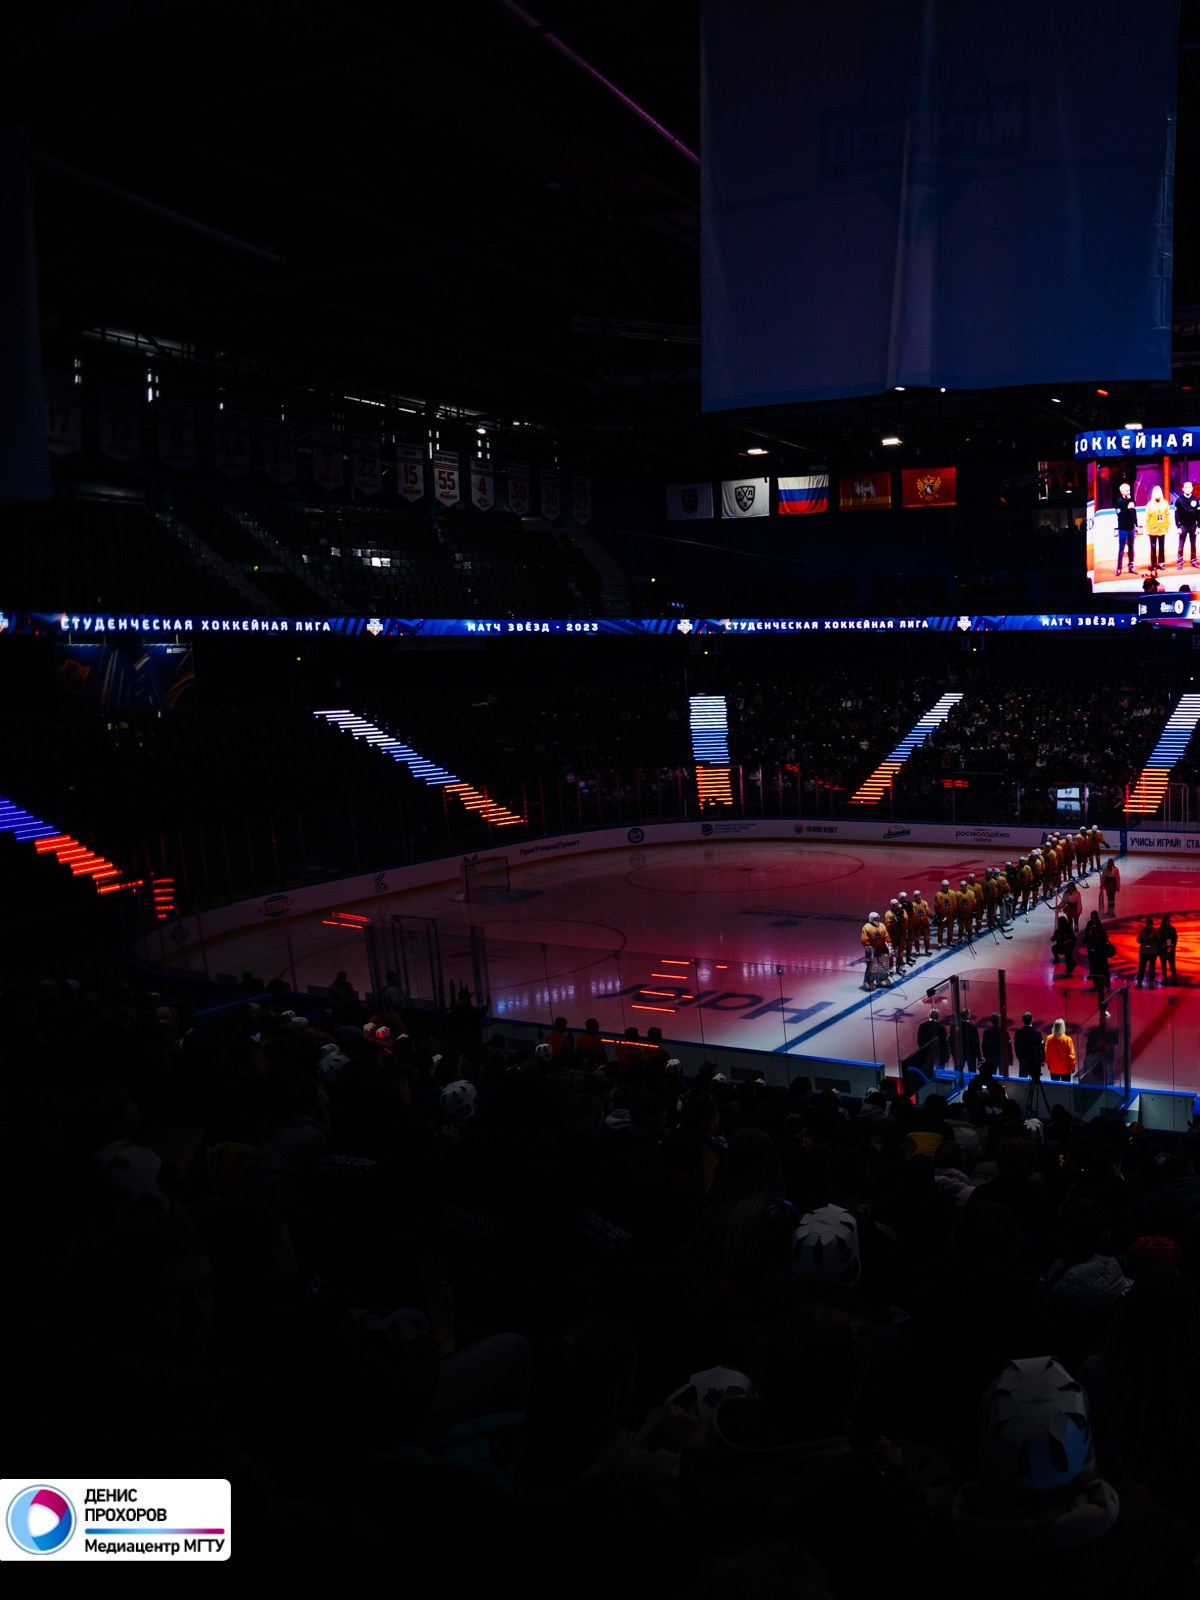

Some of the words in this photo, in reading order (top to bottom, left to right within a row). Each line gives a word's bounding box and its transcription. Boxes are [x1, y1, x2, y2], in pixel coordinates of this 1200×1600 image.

[403, 464, 418, 485] 15
[437, 470, 456, 491] 55
[477, 477, 487, 495] 4
[60, 616, 193, 632] СТУДЕНЧЕСКАЯ
[201, 619, 288, 631] ХОККЕЙНАЯ
[295, 621, 331, 632] ЛИГА
[467, 621, 501, 632] МАТЧ
[507, 620, 550, 633] ЗВЁЗД
[566, 622, 599, 632] 2023
[725, 619, 819, 631] СТУДЕНЧЕСКАЯ
[825, 618, 894, 630] ХОККЕЙНАЯ
[899, 620, 929, 629] ЛИГА
[1040, 616, 1072, 627] МАТЧ
[1077, 614, 1117, 627] ЗВЁЗД
[1130, 838, 1154, 847] УЧИСЬ
[1156, 837, 1182, 849] ИГРАЙ!
[595, 984, 834, 1026] Haier
